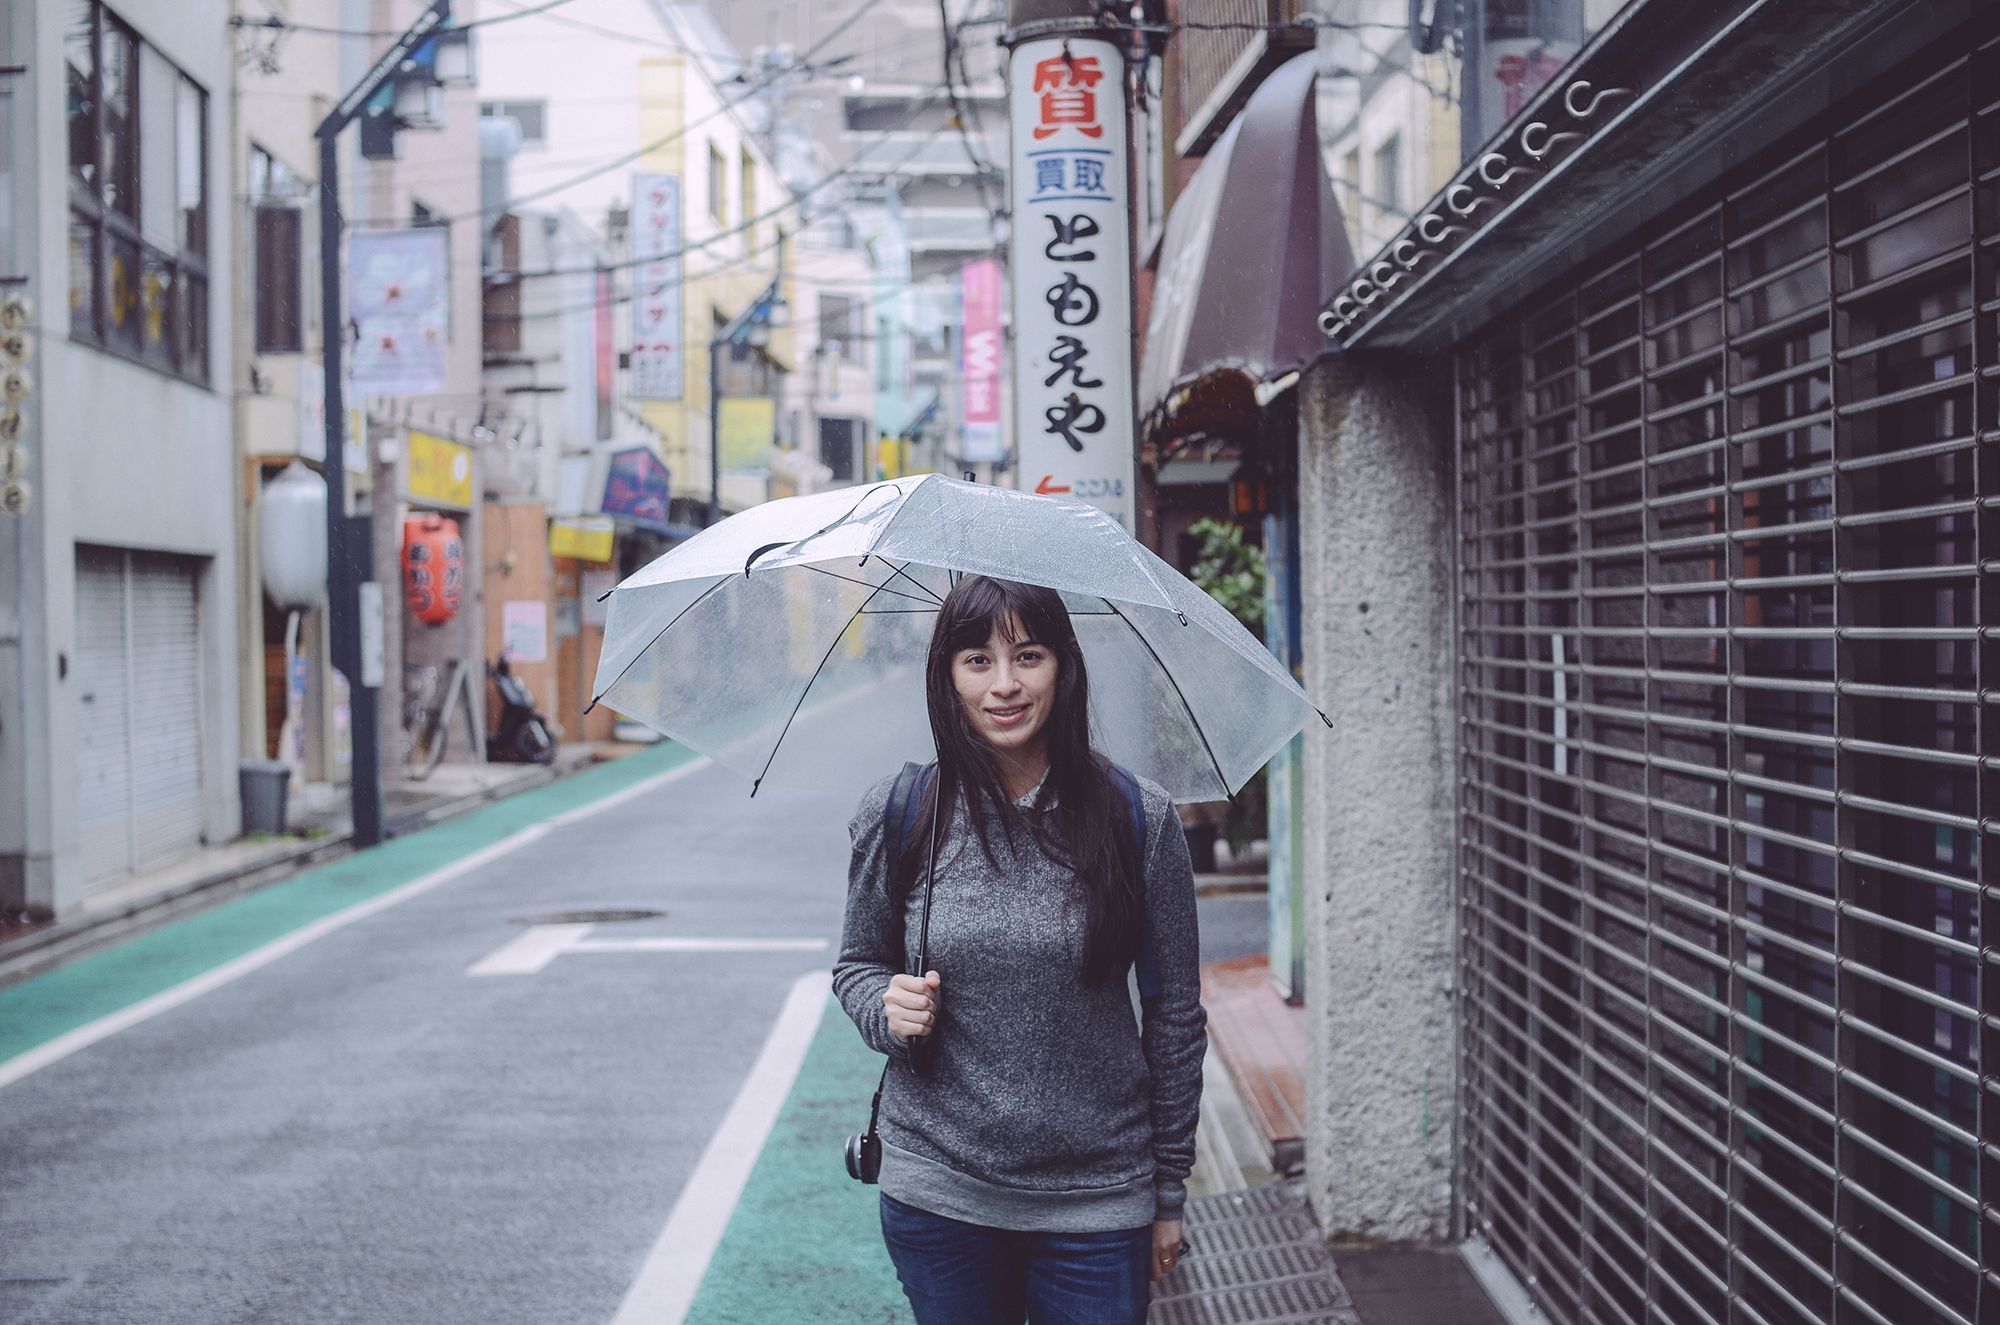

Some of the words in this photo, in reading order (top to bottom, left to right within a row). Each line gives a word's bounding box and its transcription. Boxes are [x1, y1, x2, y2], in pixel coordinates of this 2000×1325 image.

[1031, 56, 1105, 141] 質
[1034, 157, 1104, 193] 買取
[1044, 214, 1106, 452] ともえや
